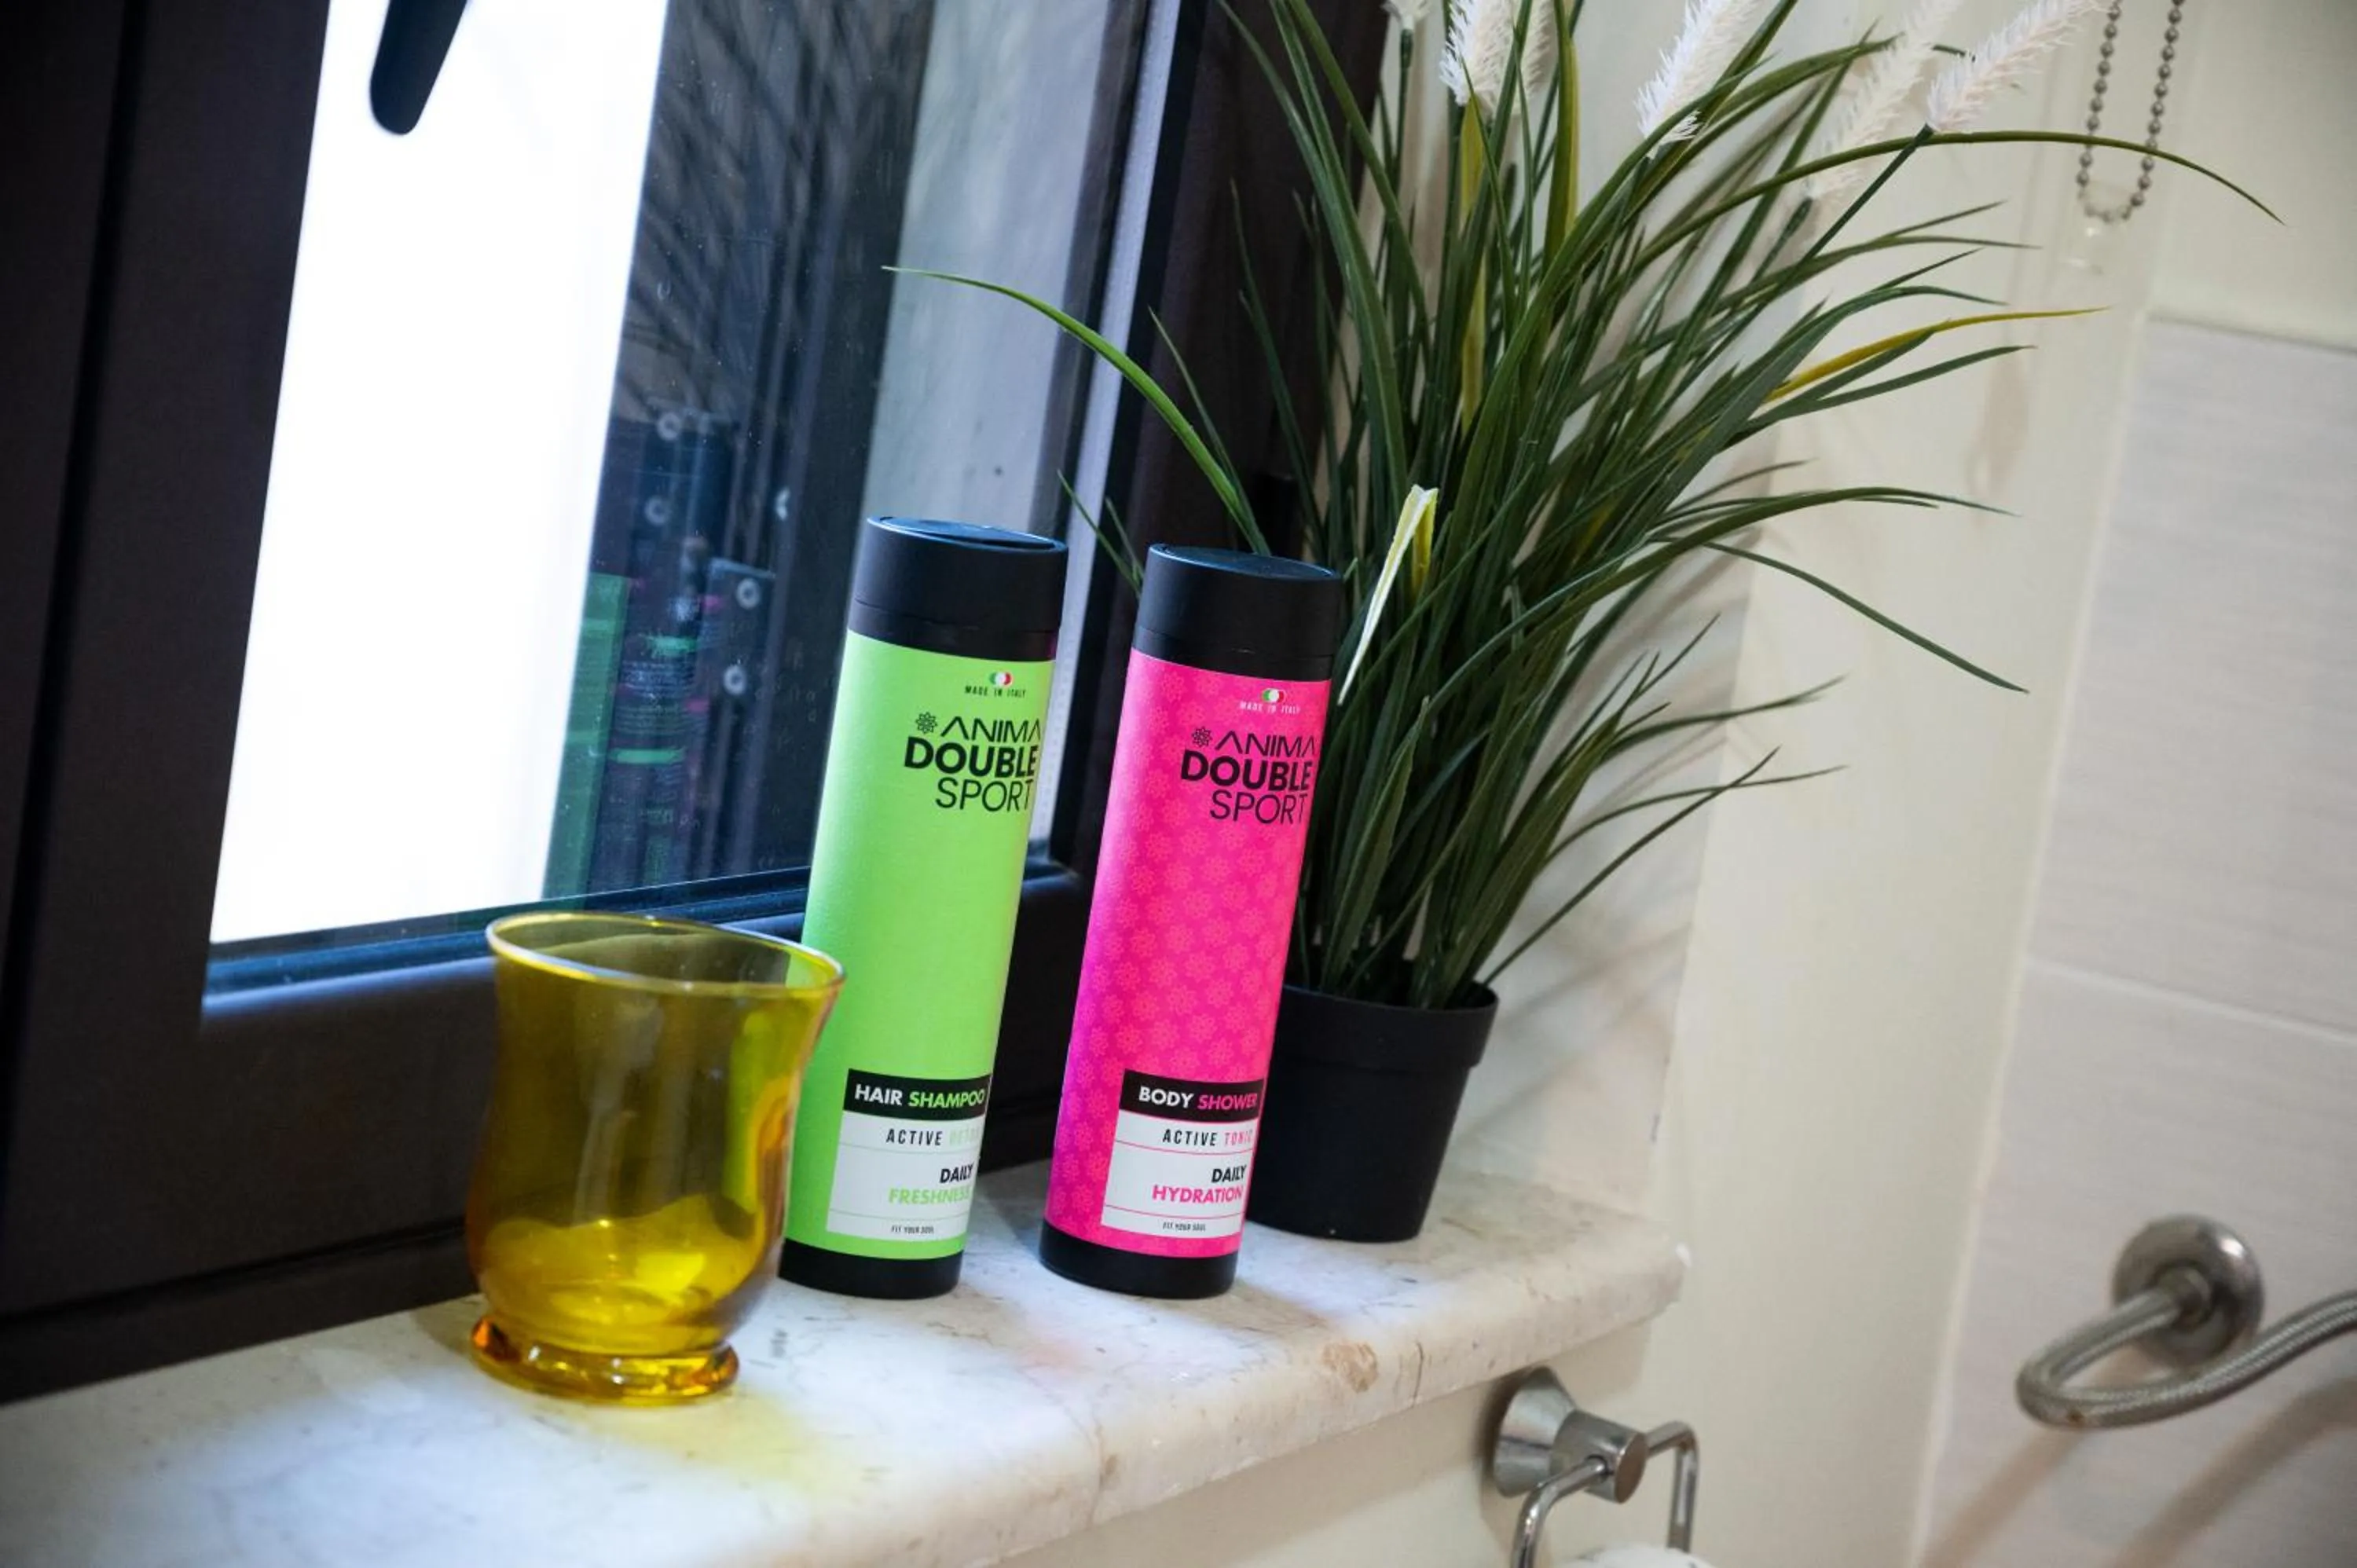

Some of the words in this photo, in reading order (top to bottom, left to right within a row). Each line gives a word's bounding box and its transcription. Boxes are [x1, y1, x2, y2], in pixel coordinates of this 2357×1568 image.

[964, 685, 988, 697] MADE
[994, 687, 1003, 698] IN
[1006, 689, 1026, 698] ITALY
[940, 716, 1041, 743] ANIMA
[1215, 731, 1315, 758] ANIMA
[904, 735, 1039, 779] DOUBLE
[1181, 749, 1313, 791] DOUBLE
[935, 777, 1034, 812] SPORT
[1210, 789, 1308, 825] SPORT
[854, 1083, 903, 1106] HAIR
[908, 1089, 985, 1108] SHAMPOO
[1138, 1086, 1194, 1108] BODY
[1197, 1093, 1258, 1110] SHOWER
[885, 1128, 943, 1146] ACTIVE
[1163, 1128, 1218, 1147] ACTIVE
[940, 1163, 974, 1183] DAILY
[1211, 1164, 1247, 1184] DAILY
[1152, 1184, 1243, 1203] HYDRATION
